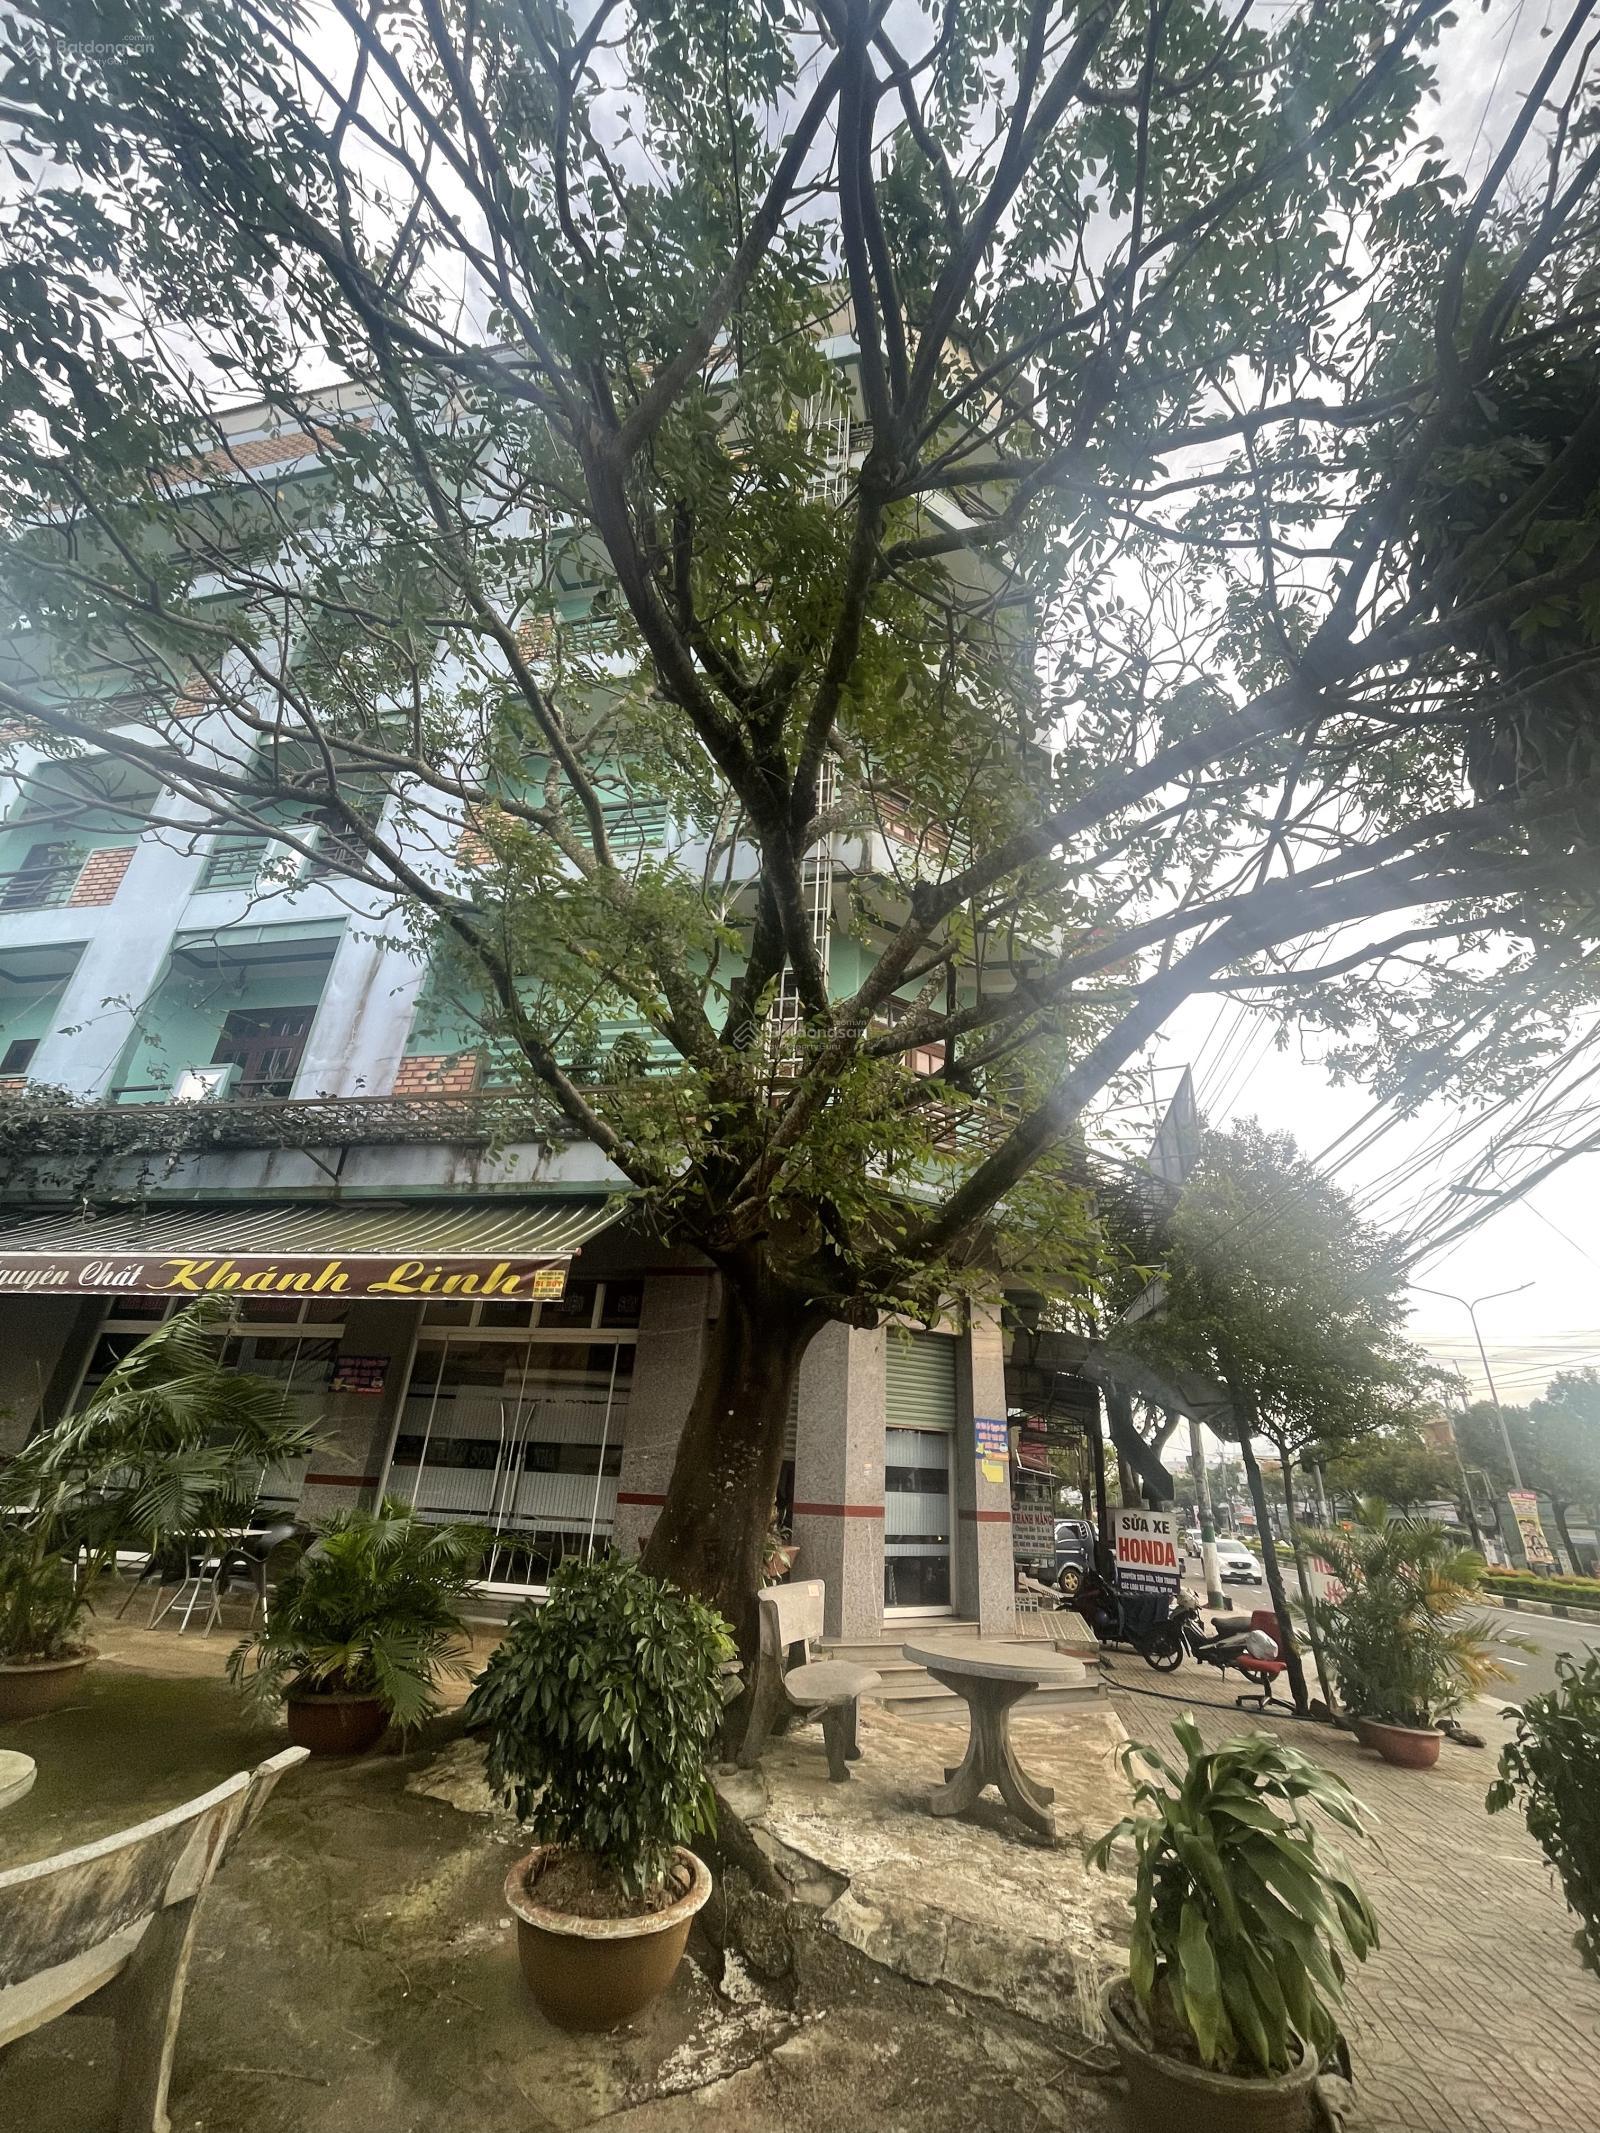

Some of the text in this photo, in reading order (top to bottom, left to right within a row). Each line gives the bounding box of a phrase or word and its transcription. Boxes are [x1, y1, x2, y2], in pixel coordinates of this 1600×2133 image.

[0, 1260, 524, 1295] guyên Chất Khánh Linh
[1122, 1514, 1170, 1534] SỬA XE
[1118, 1537, 1176, 1567] HONDA
